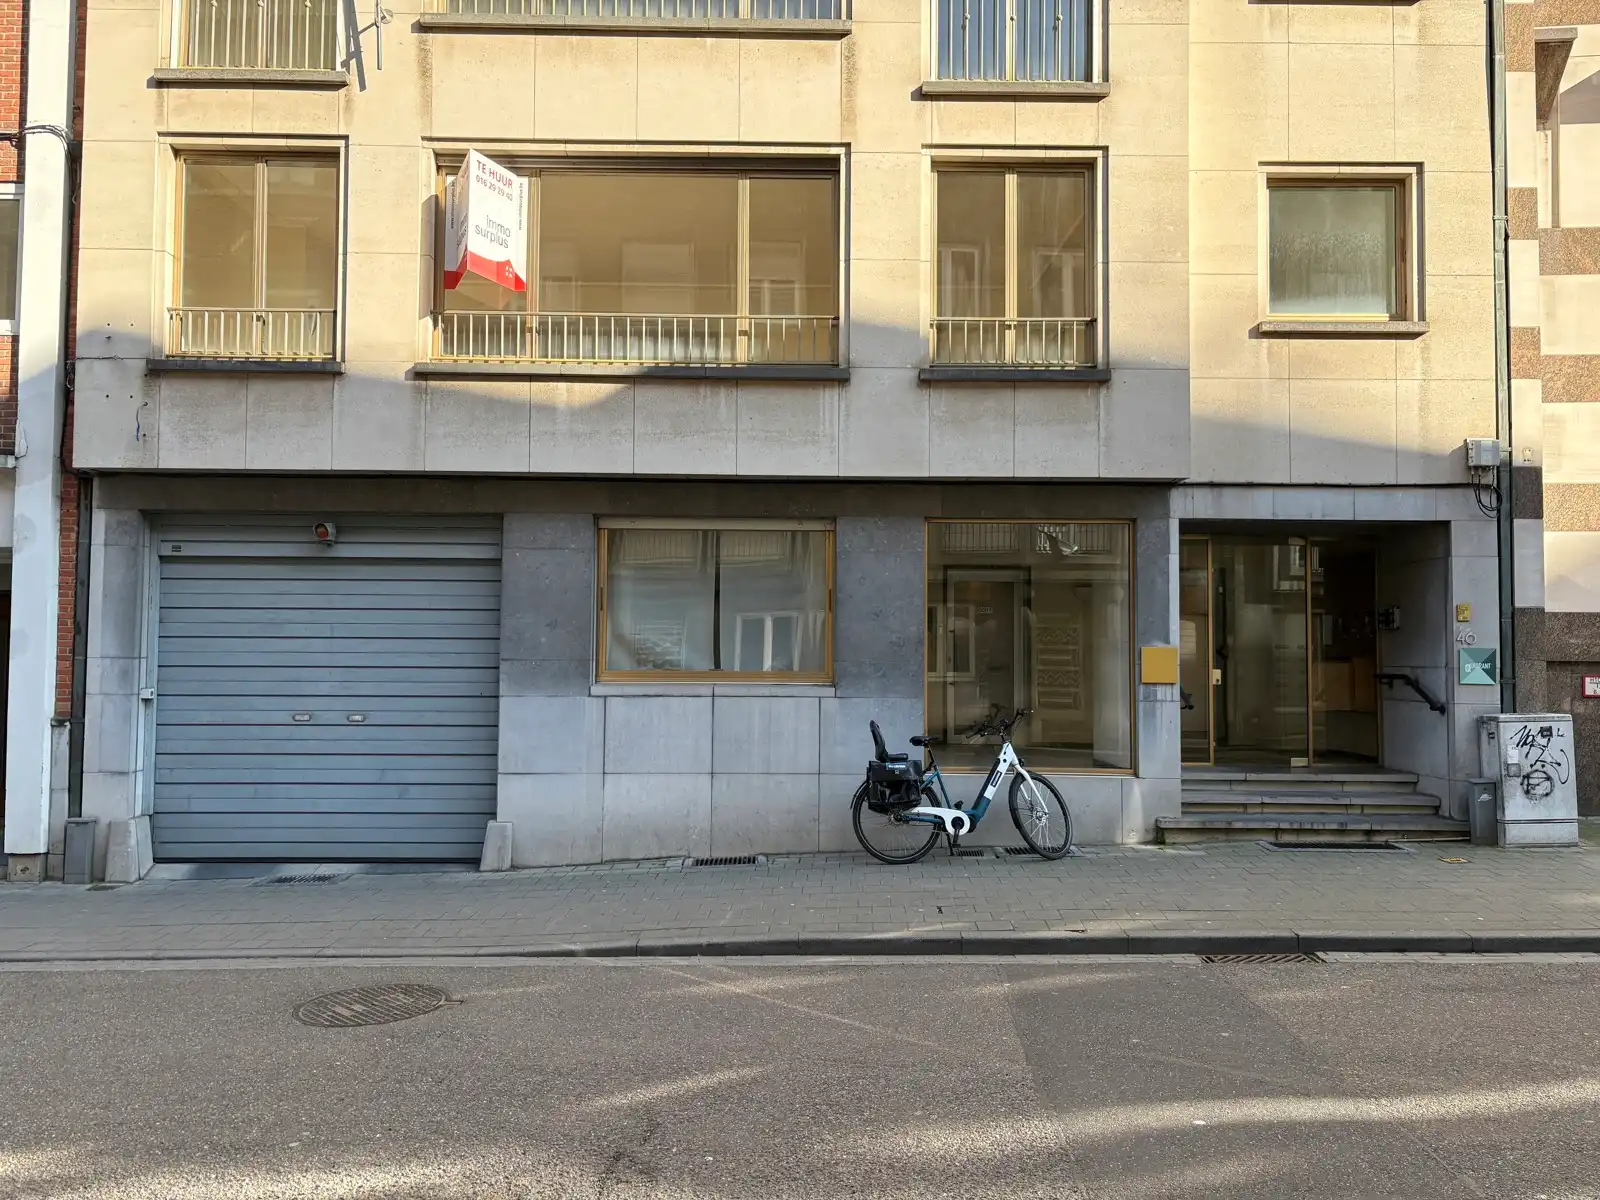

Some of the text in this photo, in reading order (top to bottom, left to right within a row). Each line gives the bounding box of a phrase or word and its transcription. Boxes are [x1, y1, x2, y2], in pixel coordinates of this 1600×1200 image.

[476, 160, 513, 189] TE HUUR
[476, 174, 488, 187] 016
[488, 182, 497, 192] 29
[497, 187, 505, 197] 29
[475, 224, 509, 249] surplus
[486, 214, 511, 238] immo
[1457, 629, 1477, 645] 46
